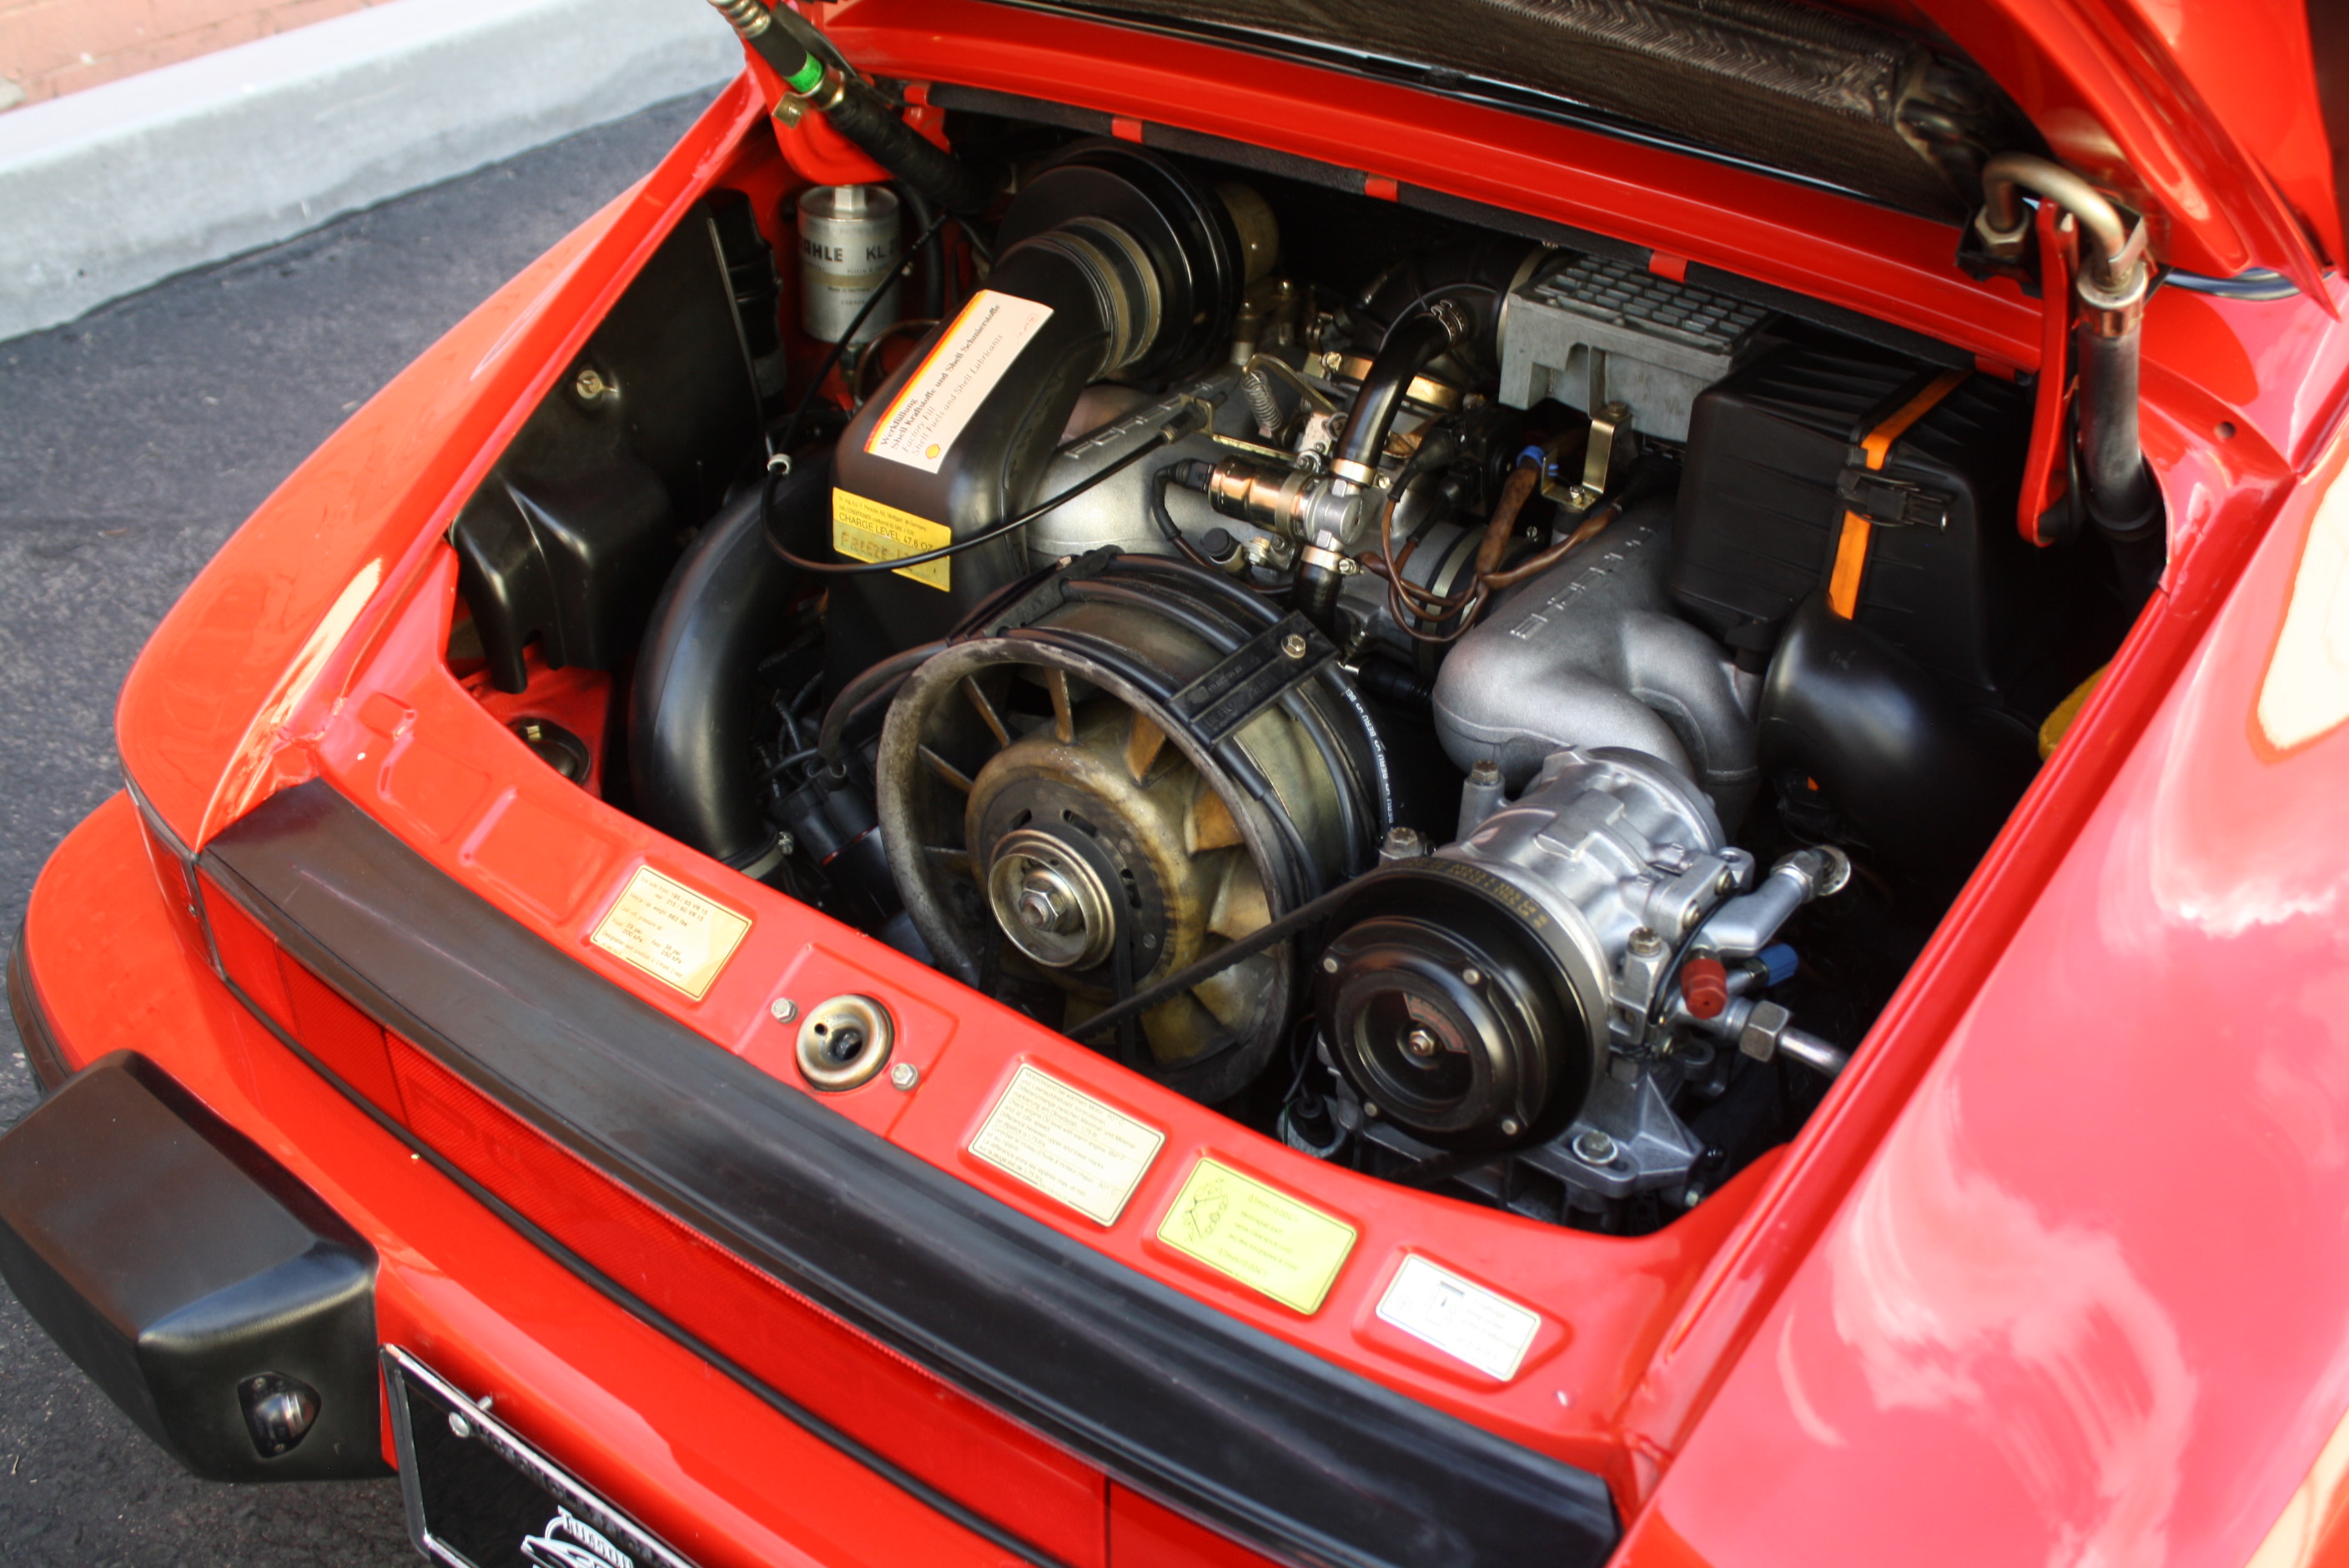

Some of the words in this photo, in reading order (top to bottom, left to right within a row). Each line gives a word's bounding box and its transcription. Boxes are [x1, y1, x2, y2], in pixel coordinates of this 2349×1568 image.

[866, 246, 886, 261] KL
[886, 425, 911, 450] Shell
[903, 387, 938, 425] Kraftstoffe
[933, 371, 950, 387] und
[943, 351, 965, 373] Shell
[959, 303, 1002, 352] Schmierstoffe
[908, 432, 933, 455] Shell
[923, 410, 947, 432] Fuels
[940, 394, 958, 410] and
[951, 373, 974, 395] Shell
[967, 332, 1003, 374] Lubricants
[876, 397, 919, 445] Werkfüllung
[897, 420, 929, 452] Factory
[919, 405, 938, 420] Fill
[838, 510, 873, 532] CHARGE
[875, 524, 900, 541] LEVEL
[903, 534, 918, 548] 47.6
[919, 540, 933, 554] OZ
[1361, 714, 1376, 737] BERU
[1378, 754, 1389, 780] BERU
